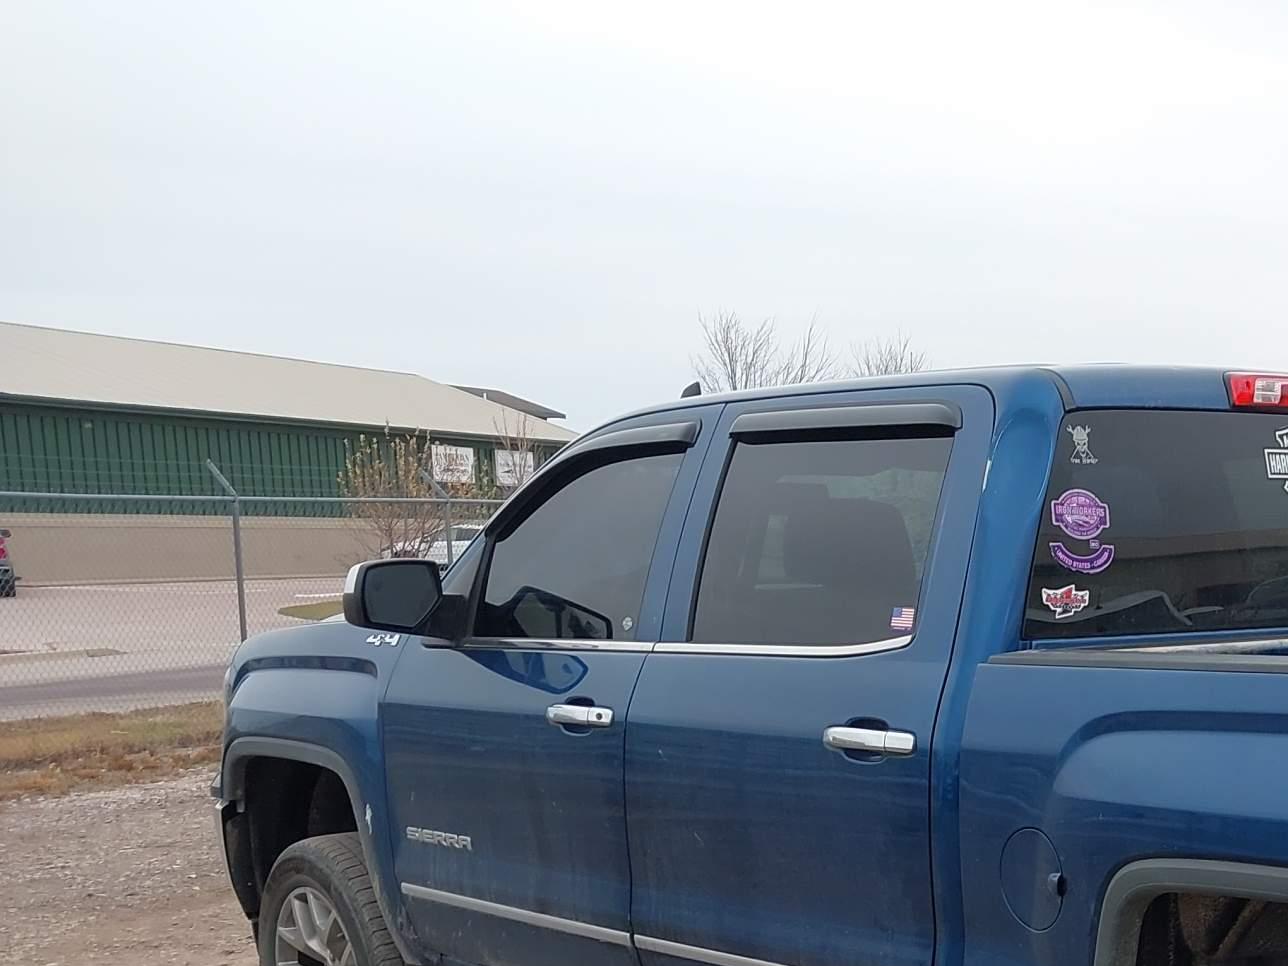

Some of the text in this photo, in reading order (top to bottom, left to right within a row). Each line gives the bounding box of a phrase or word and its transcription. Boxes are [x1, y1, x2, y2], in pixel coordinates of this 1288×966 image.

[1056, 549, 1073, 566] UNITED
[1073, 560, 1091, 569] STATES
[406, 826, 472, 851] SIERRA
